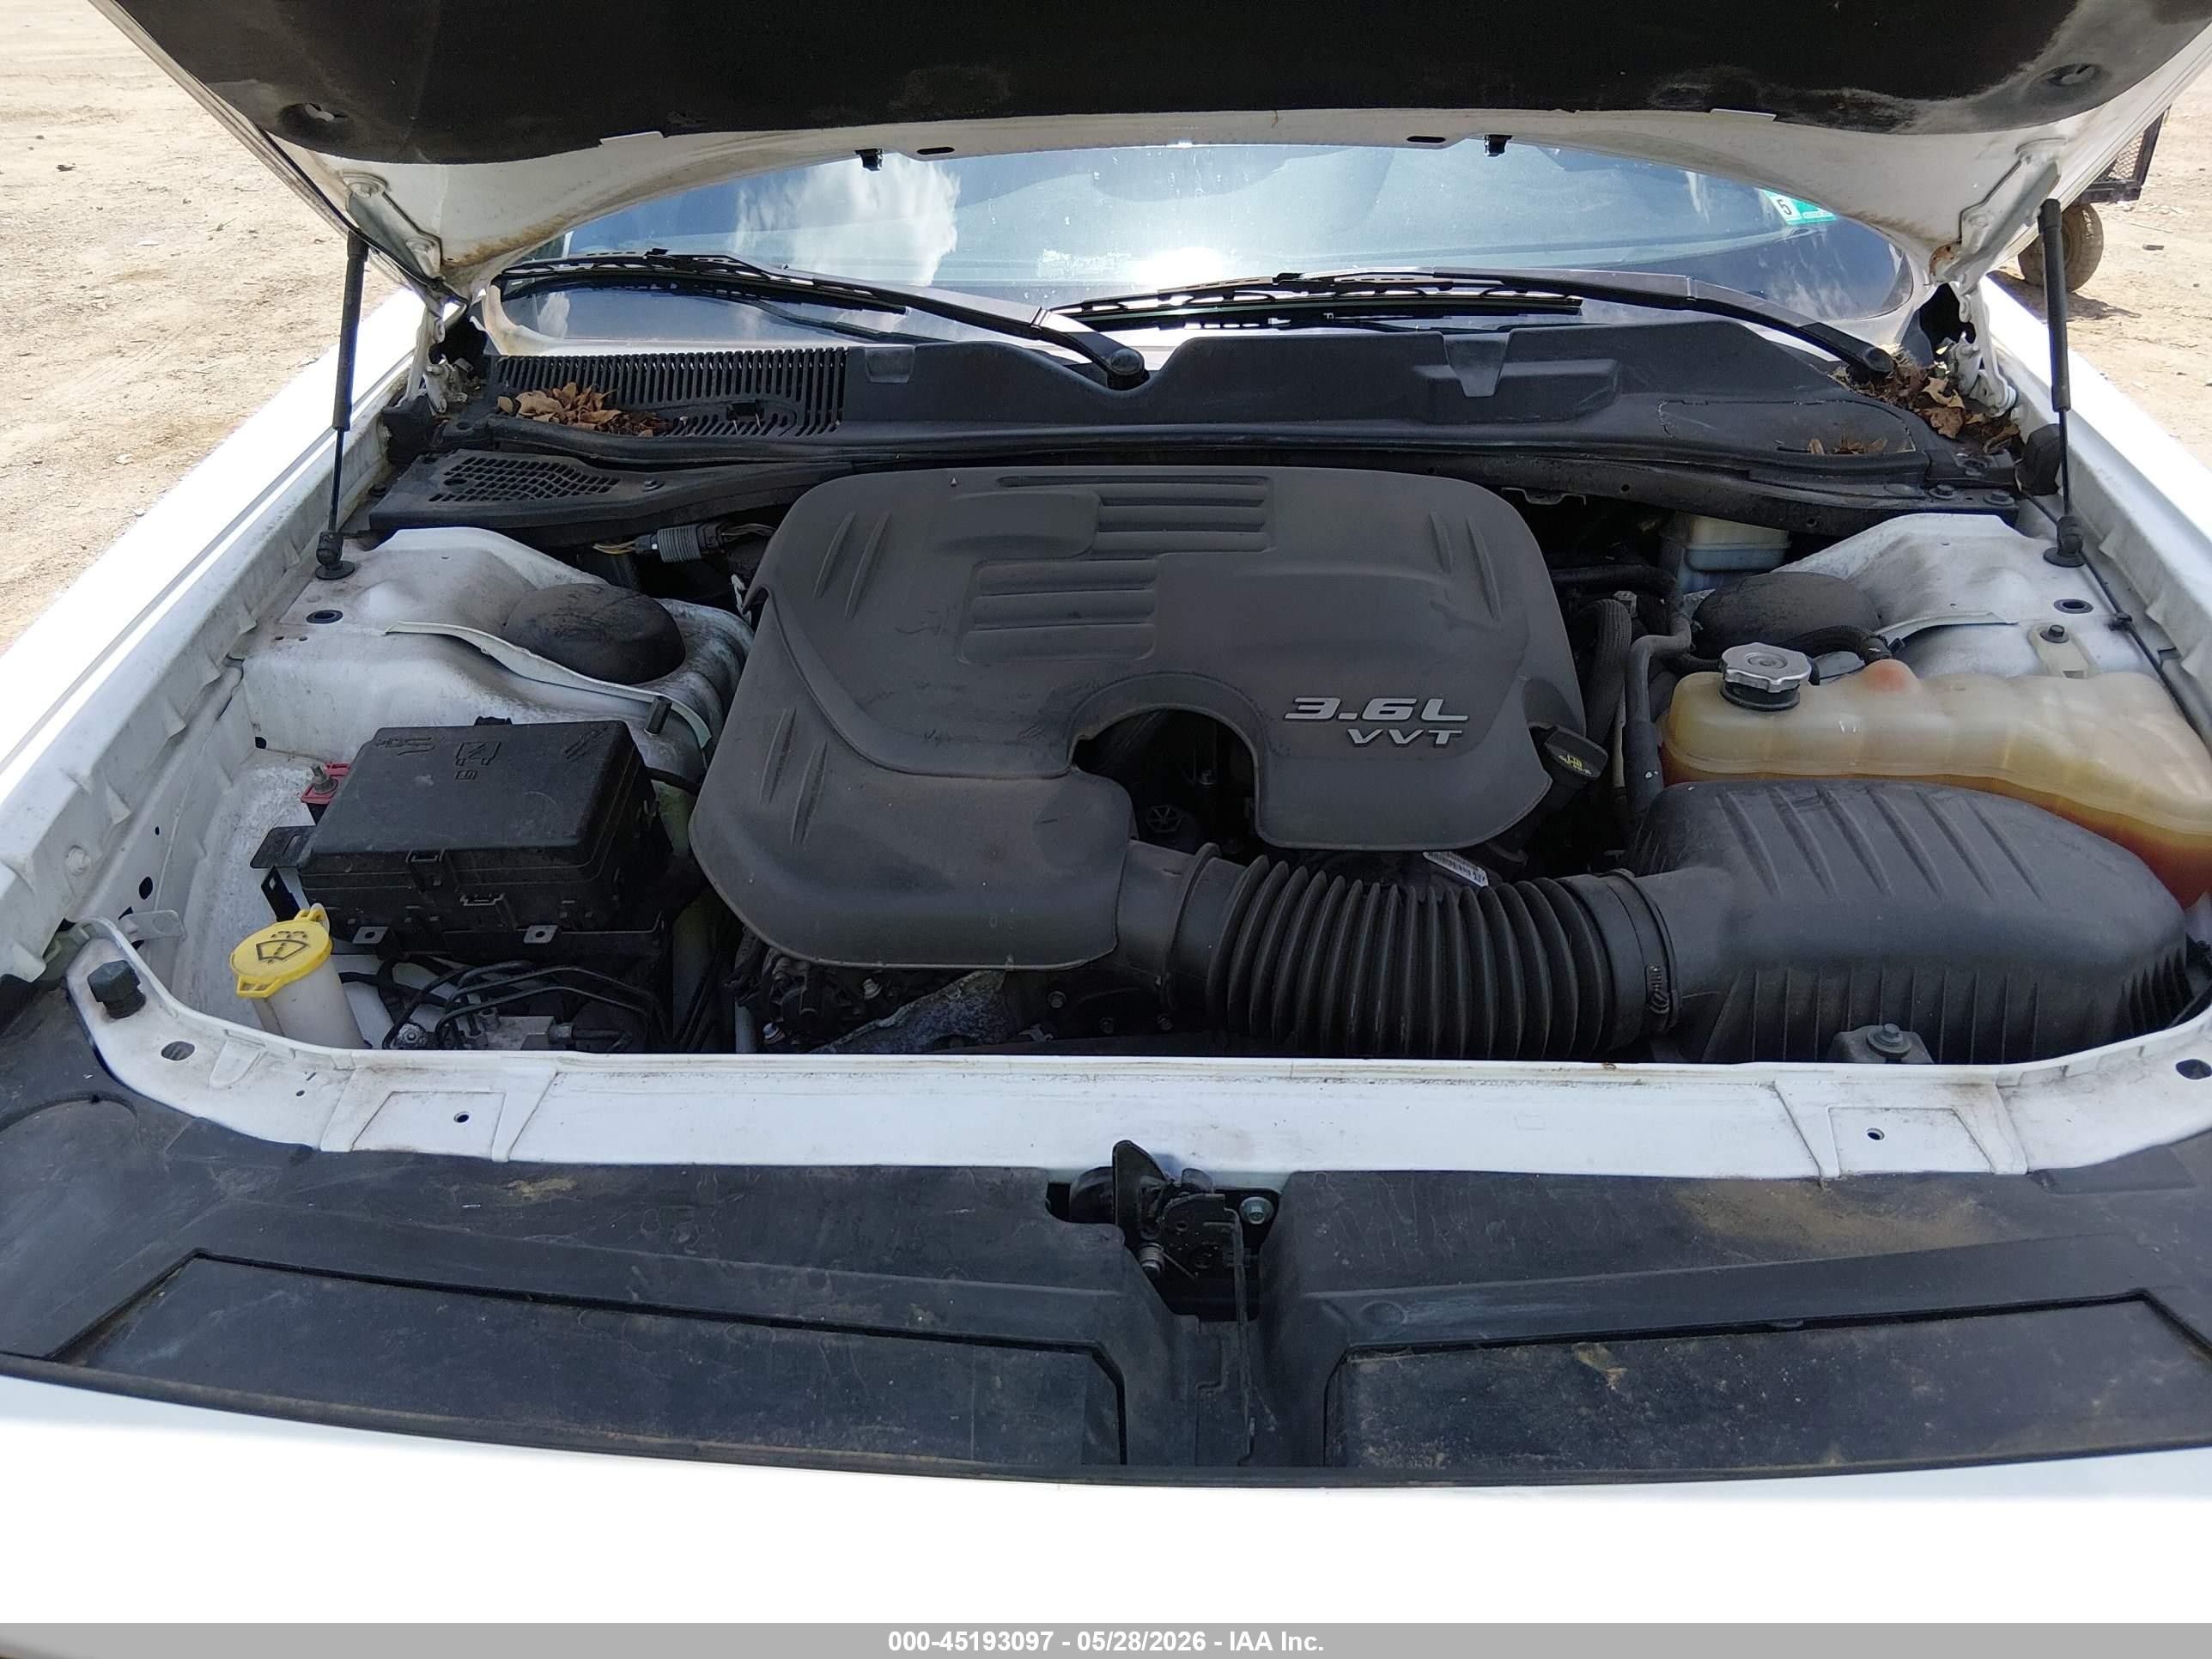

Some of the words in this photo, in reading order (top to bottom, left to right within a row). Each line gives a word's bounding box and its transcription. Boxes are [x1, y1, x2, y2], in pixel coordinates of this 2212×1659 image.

[1776, 198, 1793, 216] 5
[1285, 697, 1469, 721] 3.6L
[1347, 729, 1462, 744] VVT
